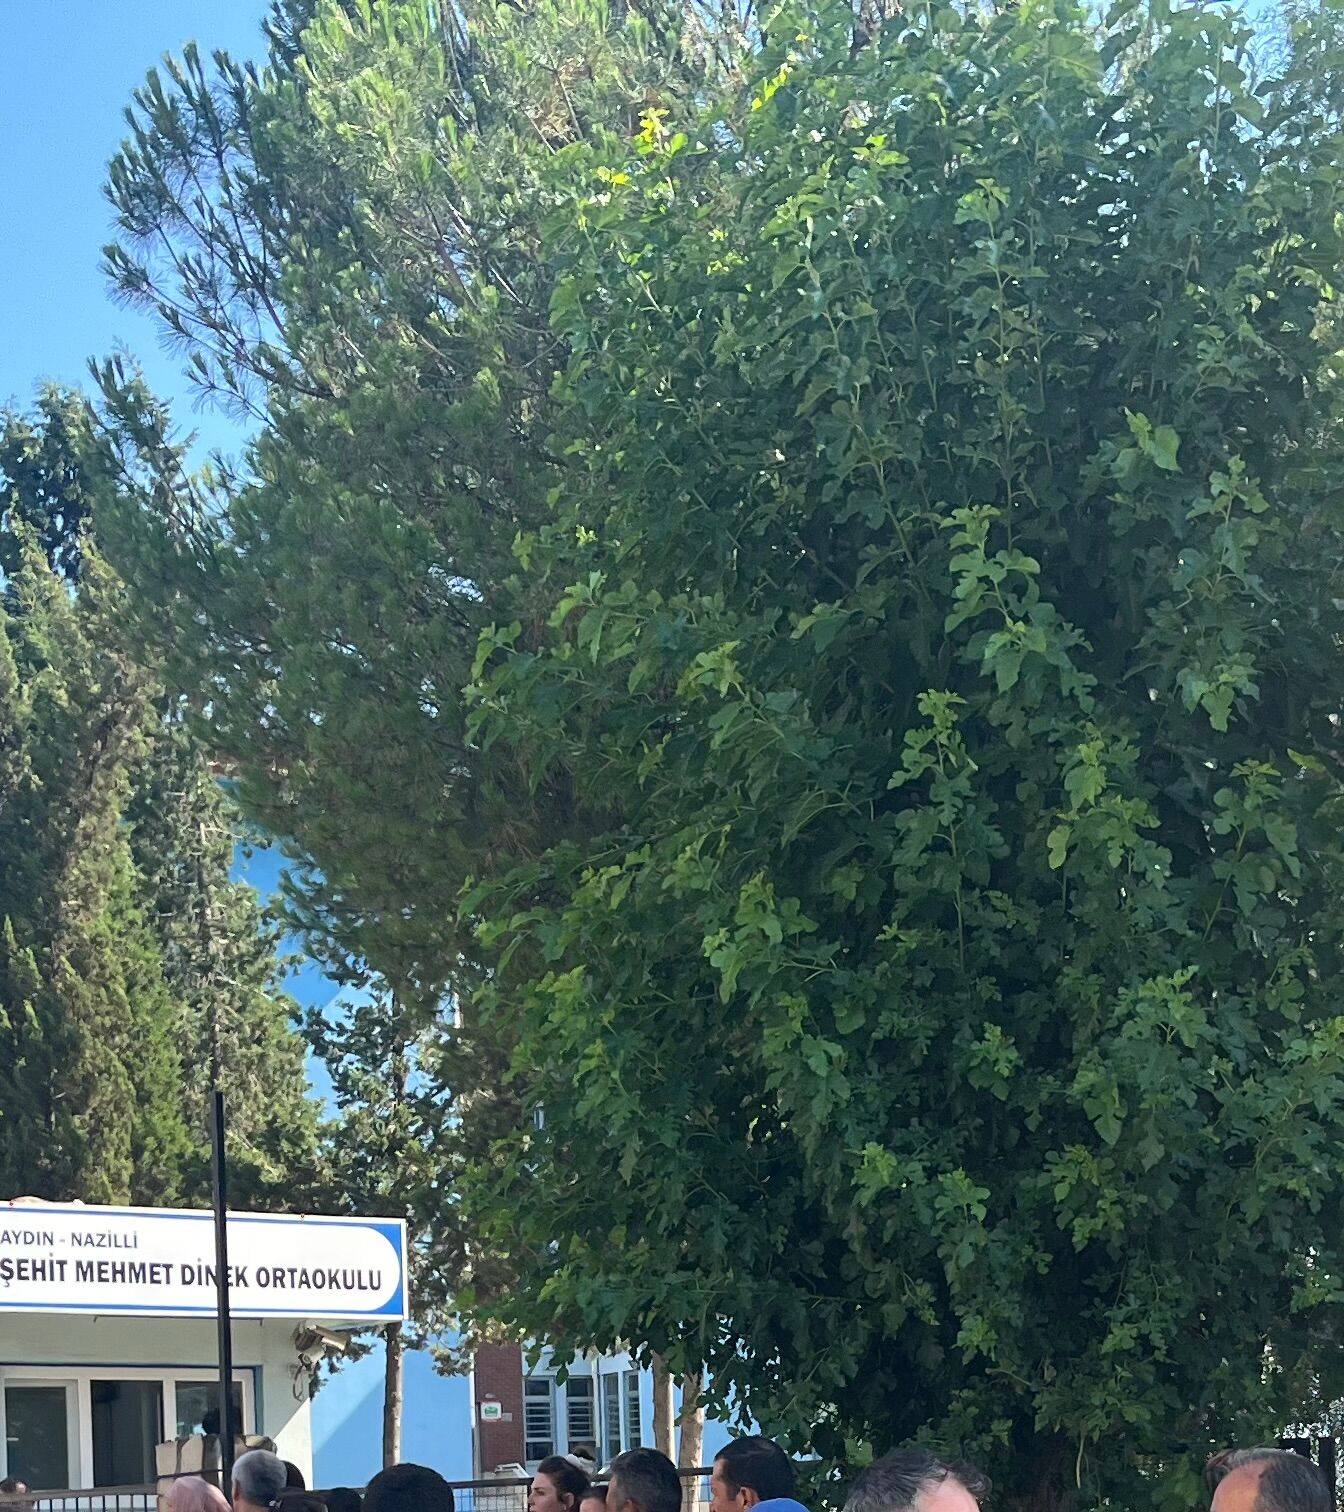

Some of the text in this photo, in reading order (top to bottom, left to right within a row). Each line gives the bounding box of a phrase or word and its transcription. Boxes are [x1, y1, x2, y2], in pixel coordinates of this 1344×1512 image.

[0, 1229, 55, 1247] AYDIN
[70, 1229, 139, 1250] NAZİLLİ
[0, 1254, 69, 1288] ŞEHİT
[74, 1262, 175, 1286] MEHMET
[255, 1265, 382, 1292] ORTAOKULU
